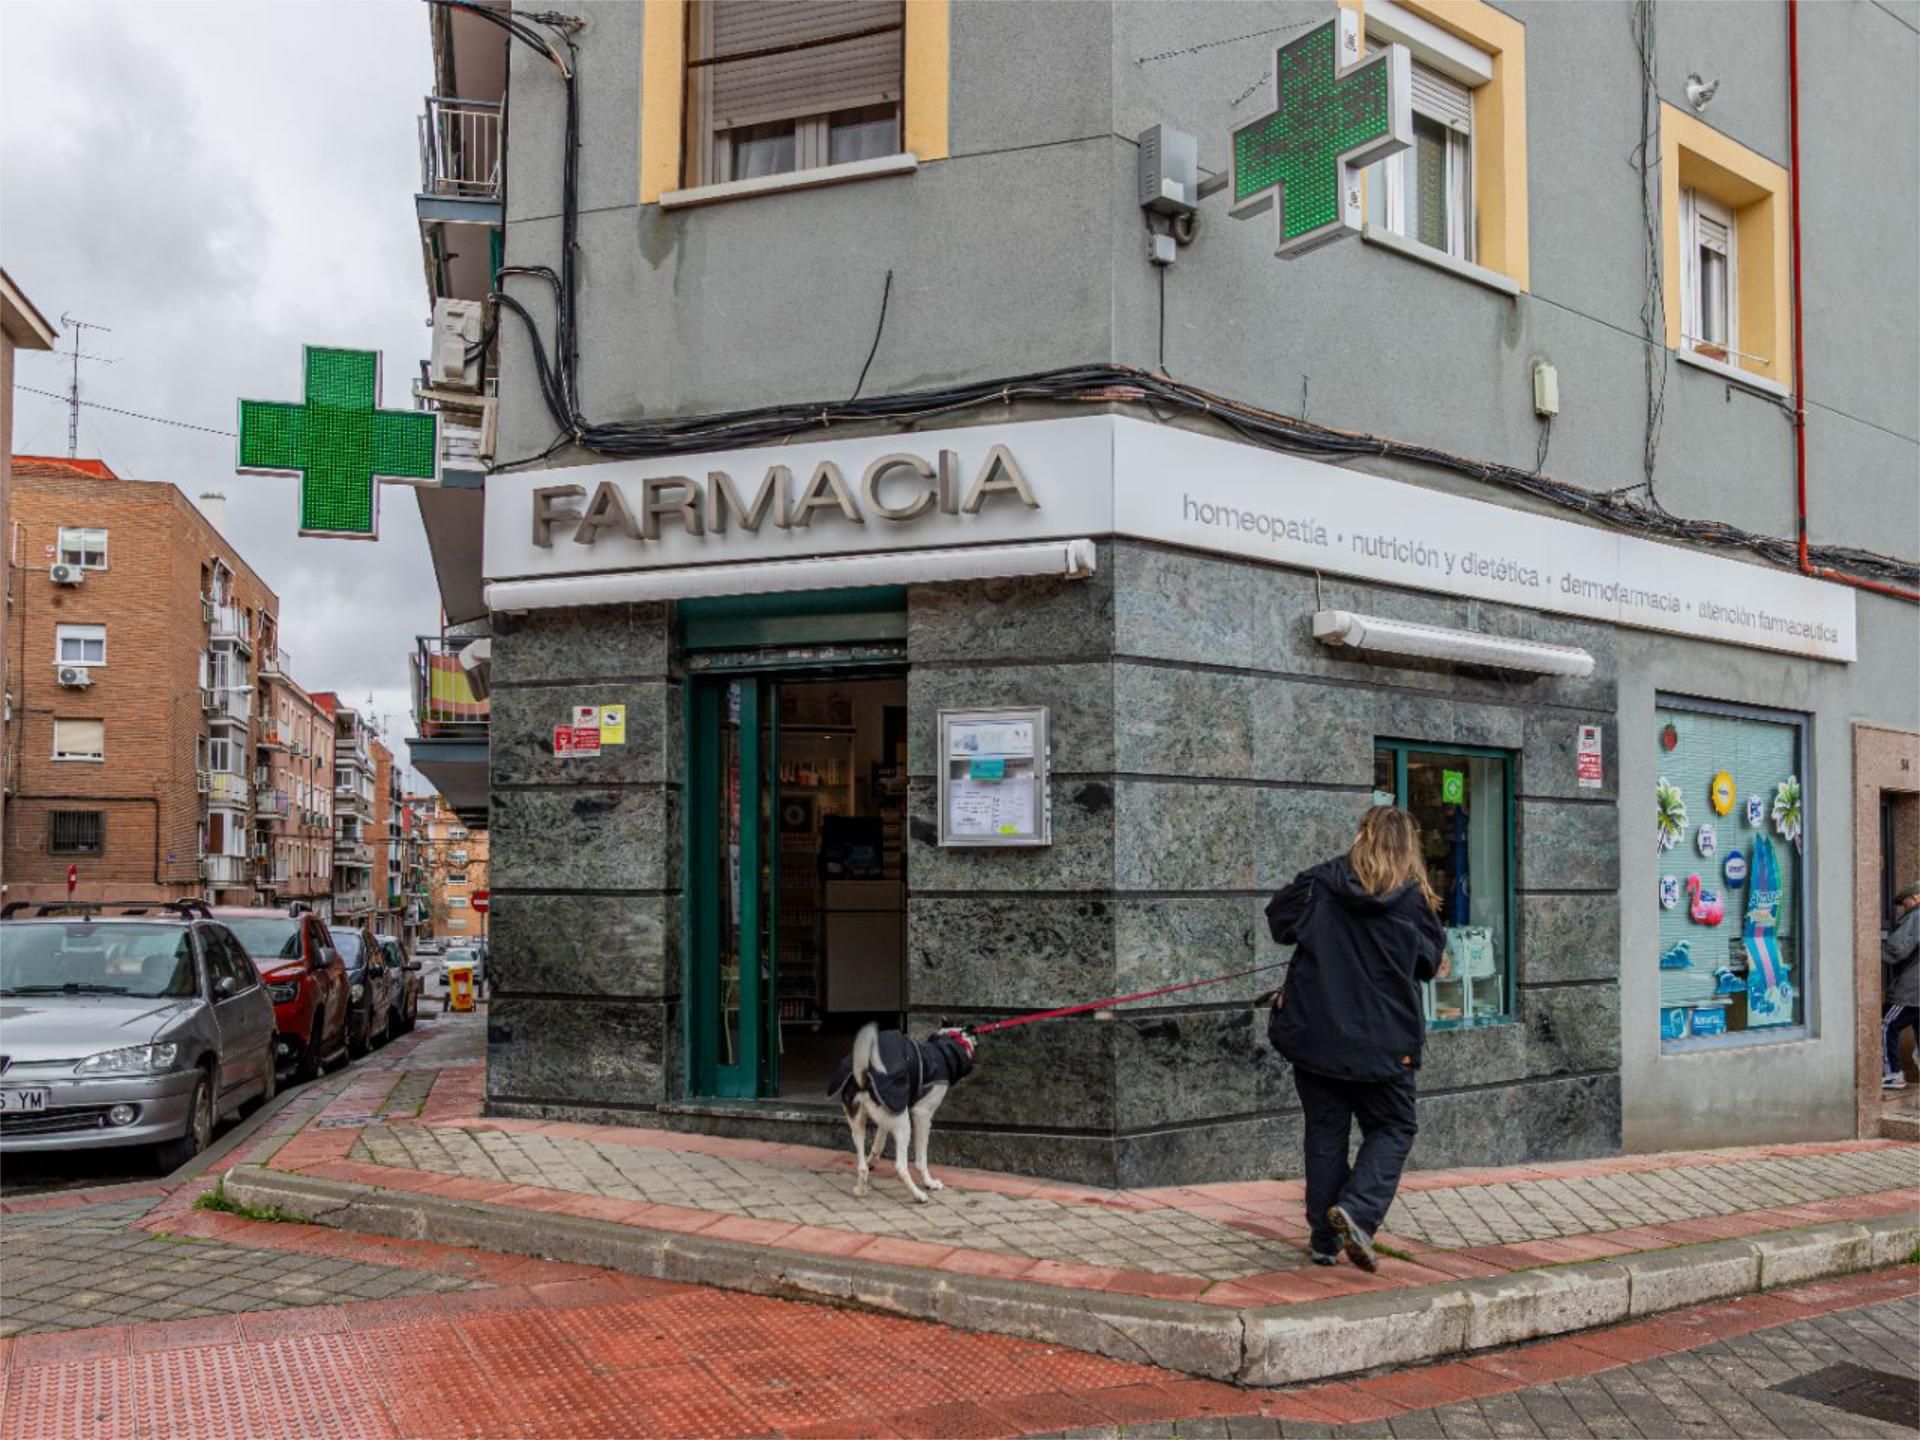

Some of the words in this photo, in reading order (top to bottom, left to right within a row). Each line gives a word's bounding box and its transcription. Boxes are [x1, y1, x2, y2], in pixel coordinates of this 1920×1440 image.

[533, 443, 1041, 548] FARMACIA
[1183, 493, 1328, 546] homeopatía
[1352, 534, 1439, 568] nutrición
[1444, 551, 1456, 575] y
[1461, 552, 1539, 587] dietética
[1560, 572, 1680, 612] dermofarmacia
[1698, 600, 1756, 629] atención
[18, 1091, 42, 1109] YM
